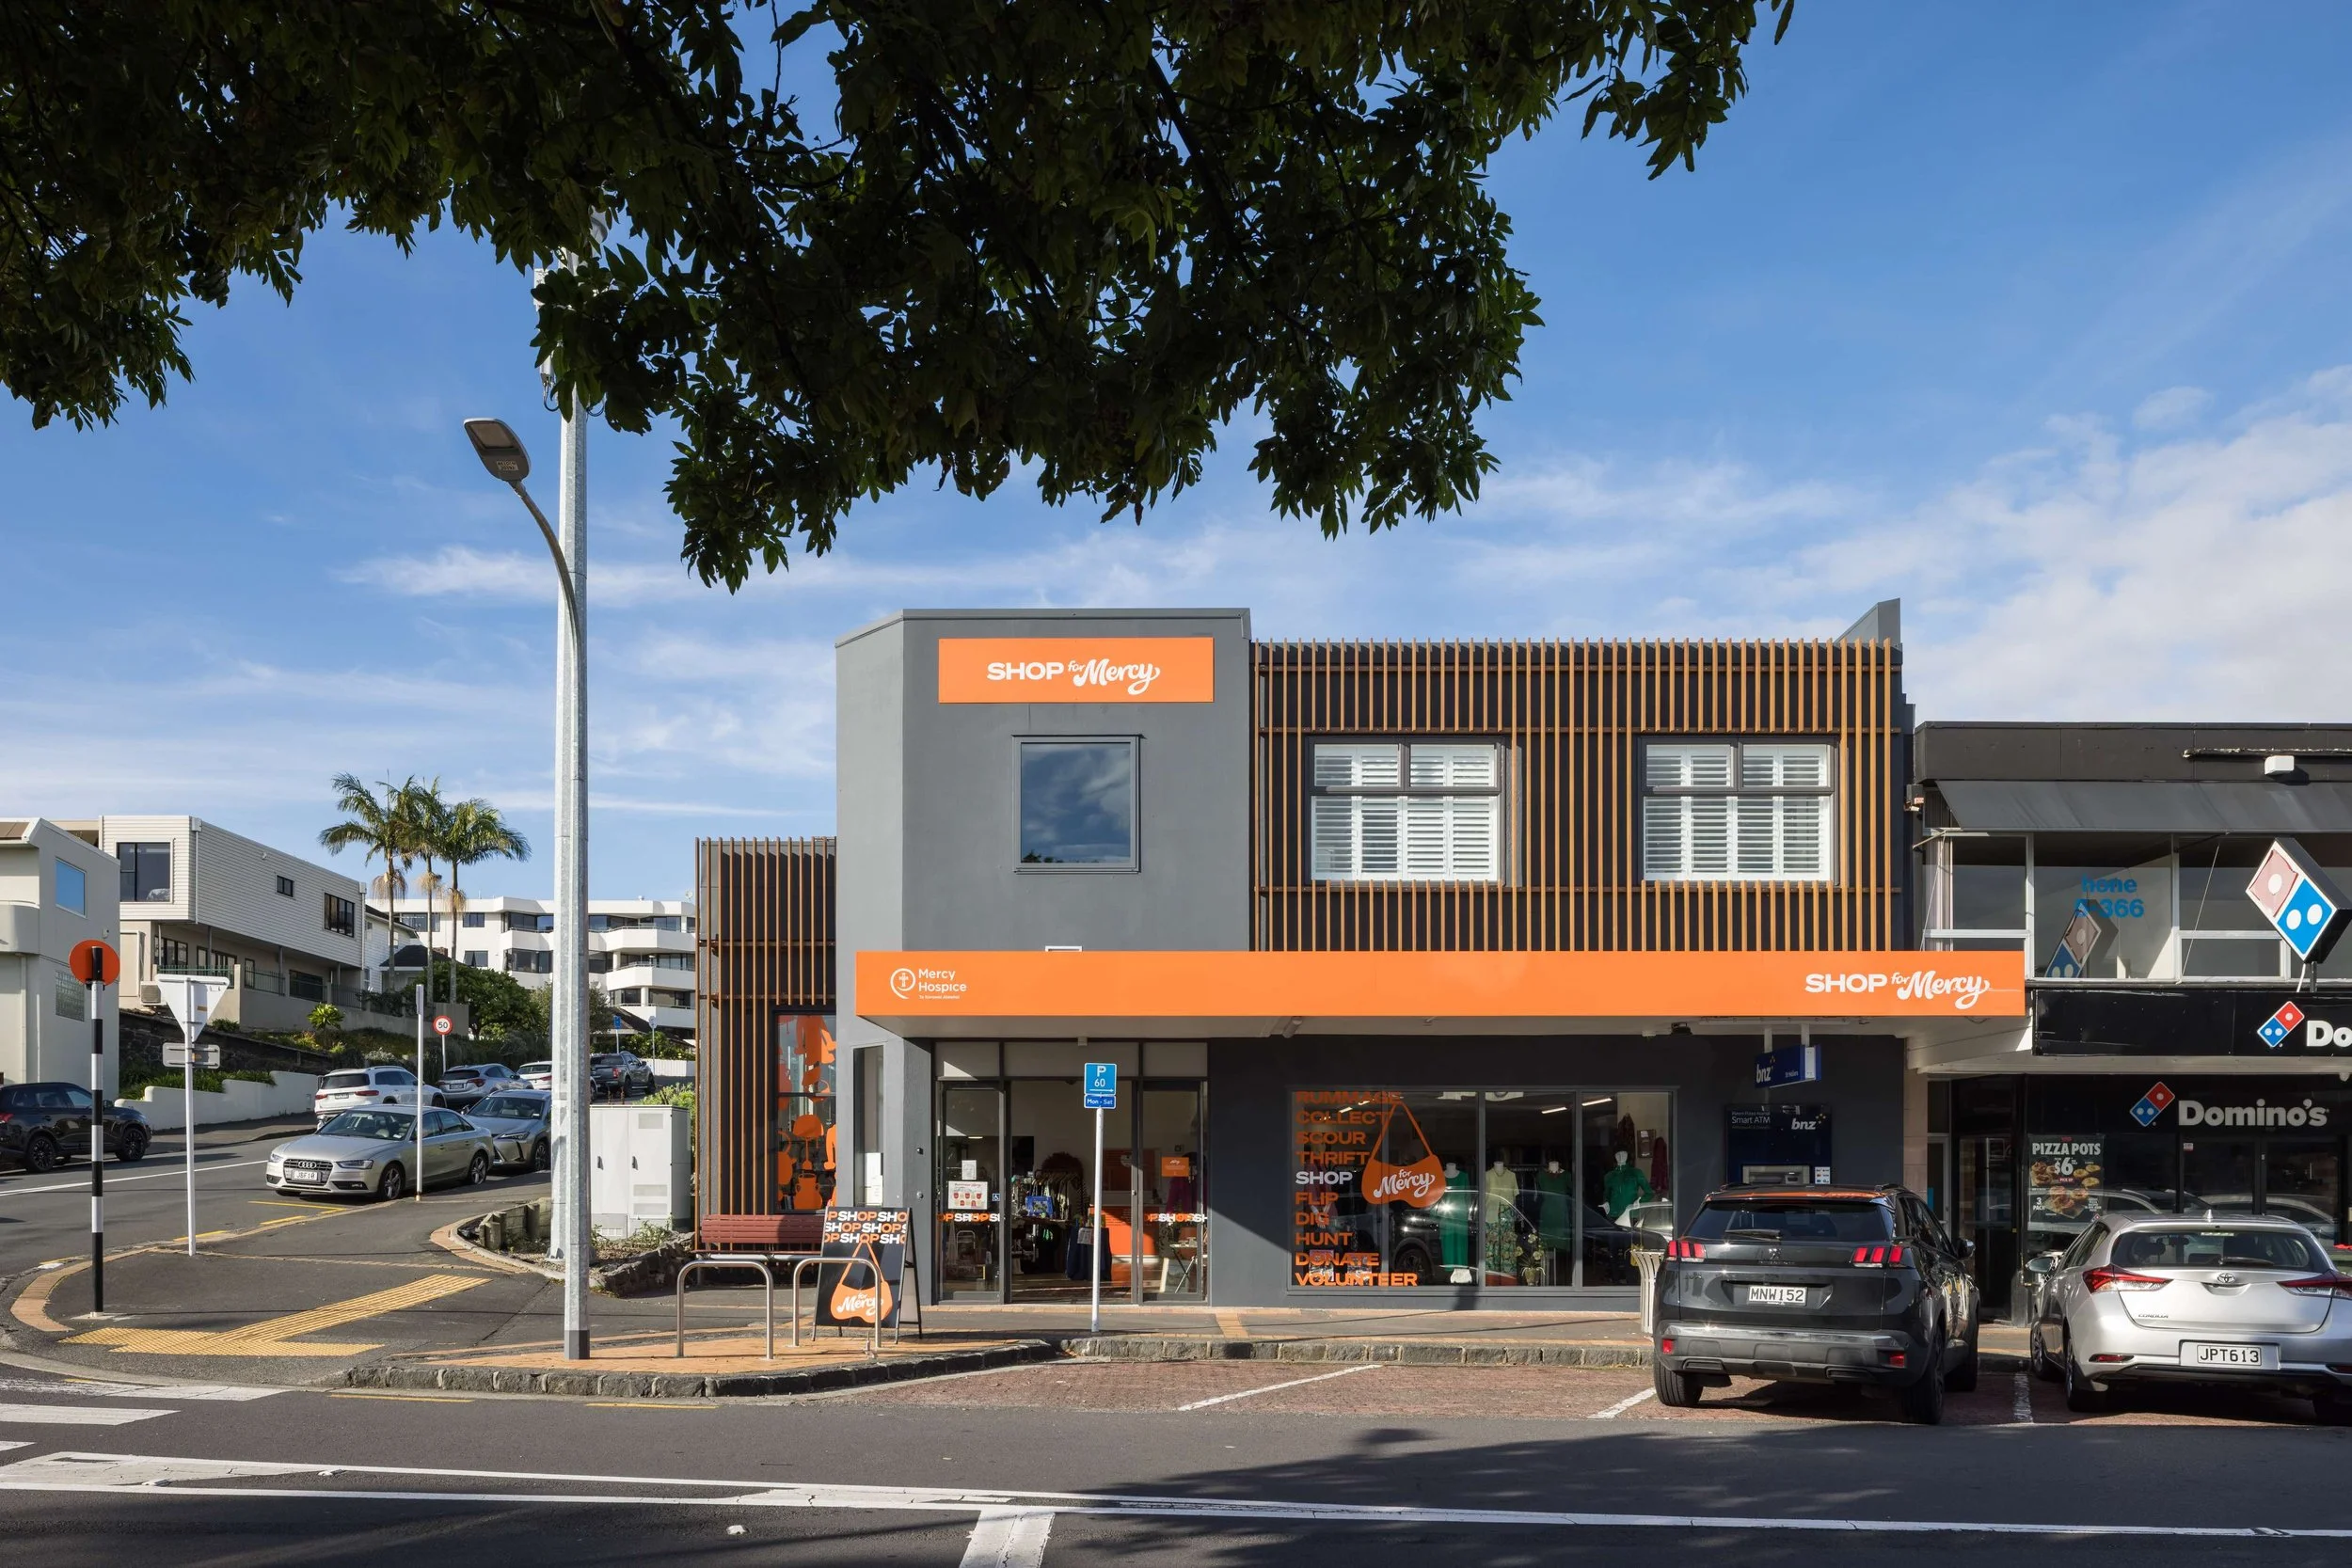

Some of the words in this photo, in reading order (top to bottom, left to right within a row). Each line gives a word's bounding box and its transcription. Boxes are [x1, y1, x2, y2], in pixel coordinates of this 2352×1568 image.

[987, 661, 1065, 681] SHOP
[1067, 660, 1086, 673] for
[1073, 658, 1161, 696] Mercy
[918, 968, 956, 981] Mercy
[1890, 972, 1911, 985] for
[918, 981, 968, 993] Hospice
[1804, 973, 1888, 993] SHOP
[1897, 970, 1991, 1010] Mercy
[1096, 1065, 1106, 1077] P
[1756, 1064, 1772, 1084] bnz
[1094, 1078, 1105, 1087] 60
[1295, 1091, 1402, 1104] RUMMAGE
[1295, 1111, 1391, 1125] COLLECT
[1754, 1116, 1771, 1124] ATM
[2178, 1099, 2328, 1127] Domino's
[1790, 1117, 1817, 1130] bnz
[1295, 1131, 1367, 1145] SCOUR
[2032, 1142, 2070, 1155] PIZZA
[2071, 1142, 2102, 1156] POTS
[1295, 1151, 1371, 1164] THRIFT
[1295, 1171, 1354, 1185] SHOP
[1398, 1168, 1412, 1178] for
[1373, 1172, 1436, 1198] Mercy
[1295, 1192, 1339, 1206] FLIP
[2036, 1196, 2042, 1205] 3
[1295, 1212, 1330, 1226] DIG
[1295, 1232, 1354, 1246] HUNT
[1295, 1252, 1380, 1266] DONATE
[1295, 1272, 1418, 1287] VOLUNTEER
[1751, 1289, 1804, 1302] MNW152
[2200, 1347, 2260, 1363] JPT613
